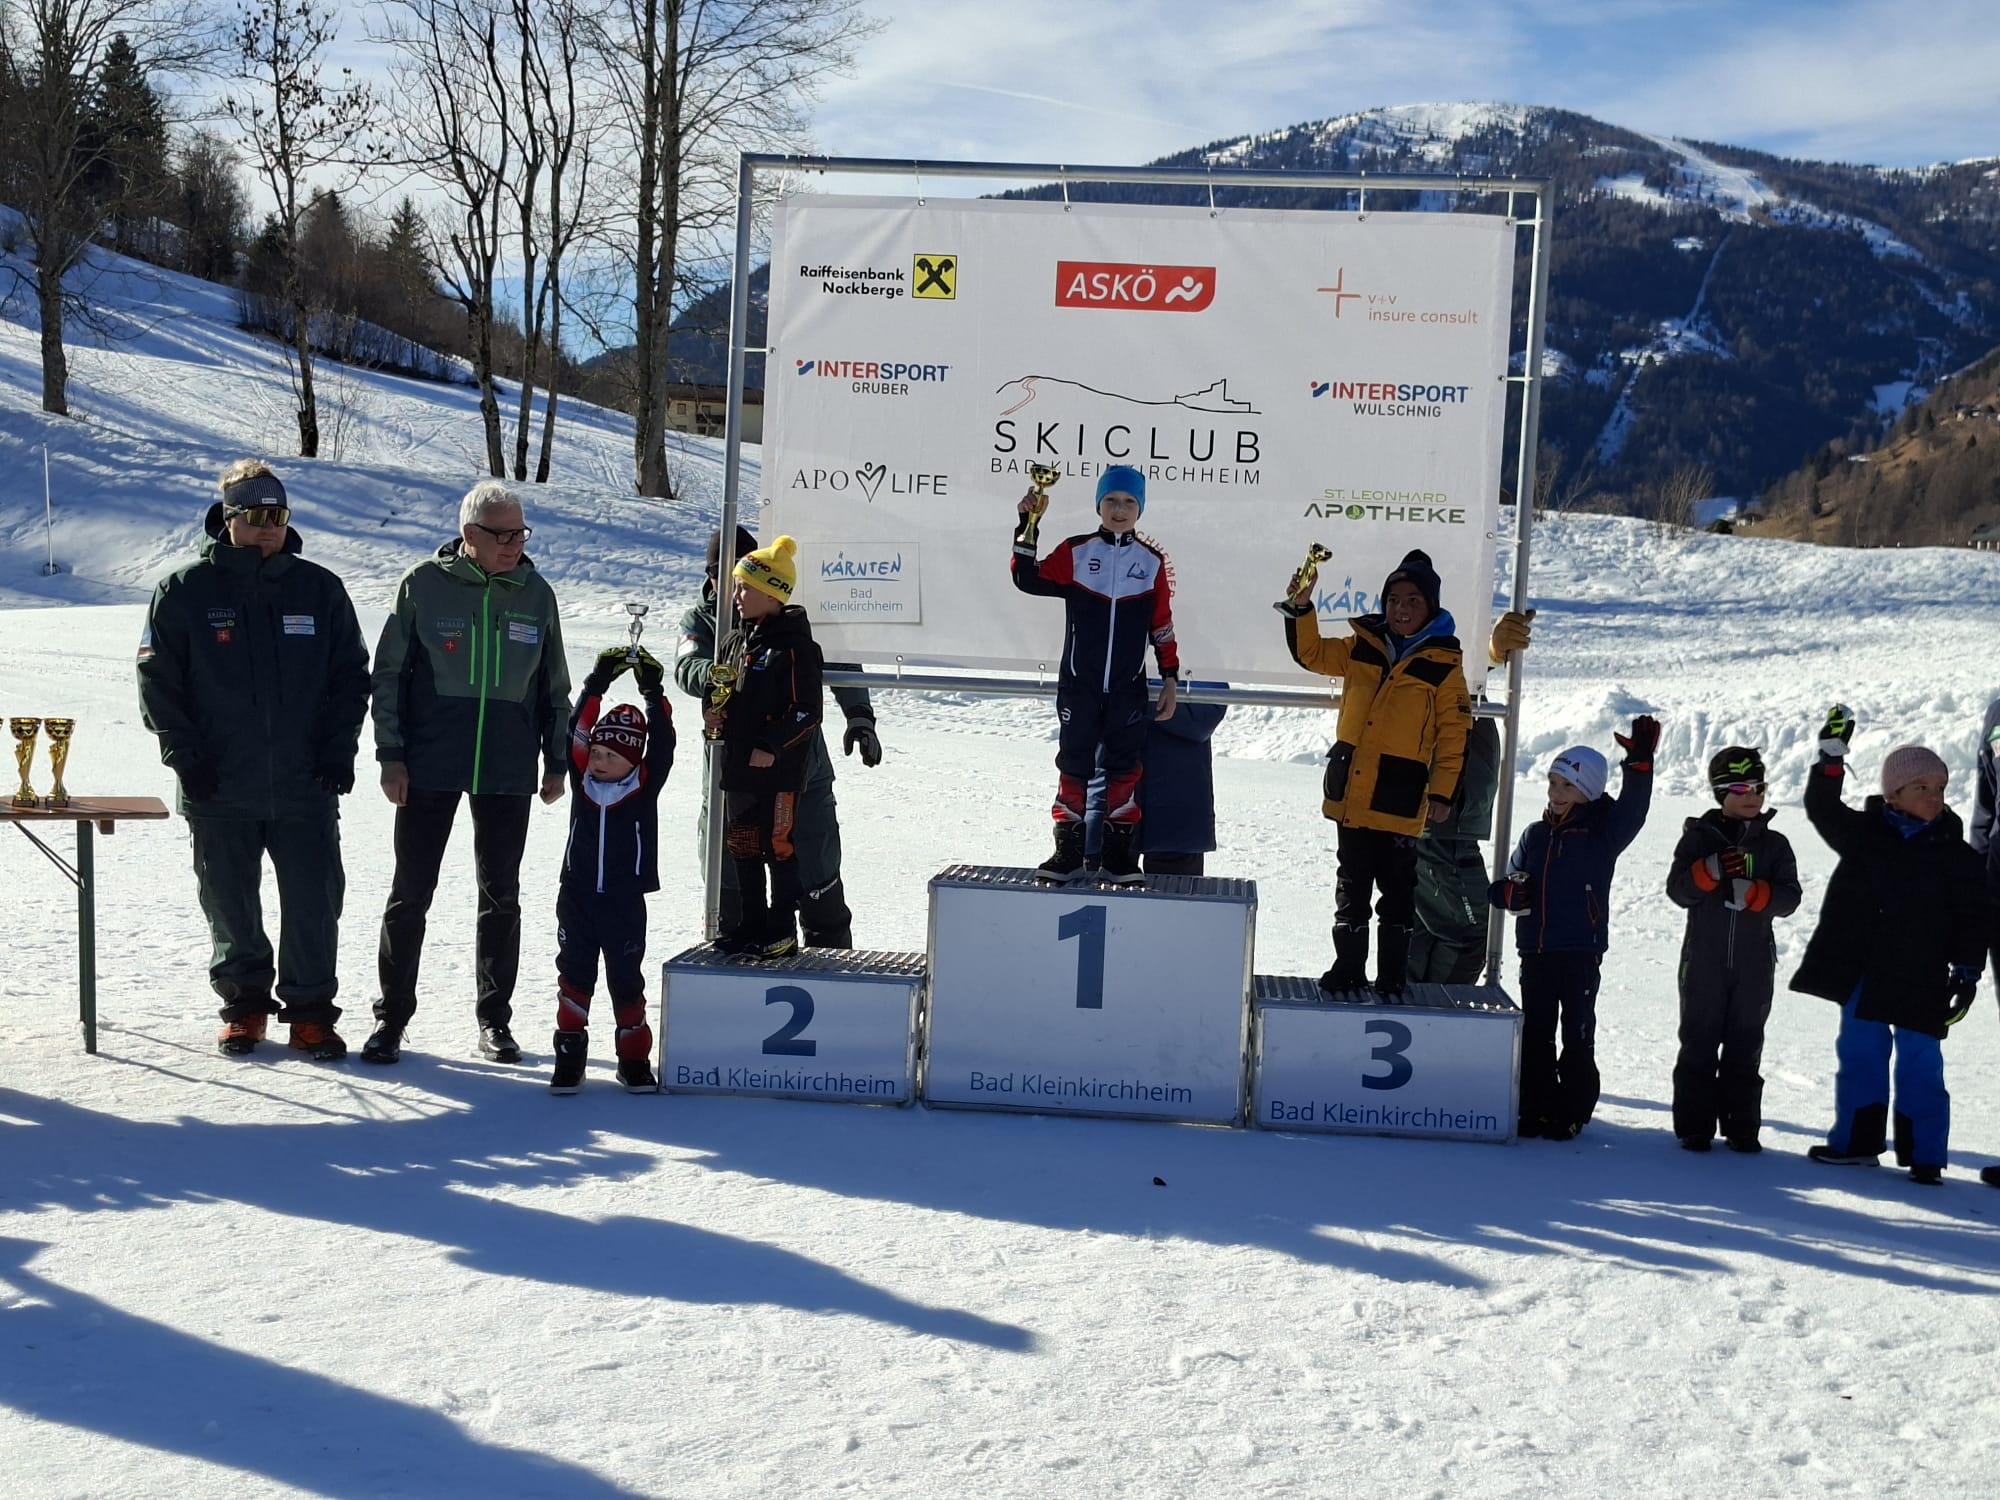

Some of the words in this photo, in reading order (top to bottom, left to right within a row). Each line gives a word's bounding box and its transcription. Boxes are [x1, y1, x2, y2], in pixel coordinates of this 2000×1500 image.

[800, 265, 904, 281] Raiffeisenbank
[823, 282, 904, 299] Nockberge
[1066, 268, 1157, 302] ASKÖ
[1369, 308, 1416, 322] insure
[1420, 309, 1478, 324] consult
[817, 360, 949, 382] INTERSPORT
[852, 382, 909, 395] GRUBER
[1332, 382, 1469, 403] INTERSPORT
[1353, 403, 1442, 418] WULSCHNIG
[993, 420, 1261, 464] SKICLUB
[791, 468, 849, 491] APO
[891, 473, 948, 496] LIFE
[1052, 460, 1261, 485] KLEIIRCHHEIM
[1324, 488, 1345, 500] ST.
[1351, 489, 1447, 503] LEONHARD
[1304, 503, 1466, 524] APOTHEKE
[821, 551, 901, 577] KÄRNTEN
[850, 588, 872, 599] Bad
[820, 600, 903, 612] Kleinkirchheim
[596, 731, 643, 748] SPORT
[1058, 904, 1107, 1009] 1
[762, 985, 817, 1057] 2
[1361, 1019, 1413, 1090] 3
[677, 1065, 720, 1087] Bad
[728, 1067, 895, 1095] Kleinkirchheim
[970, 1071, 1013, 1092] Bad
[1022, 1074, 1192, 1103] Kleinkirchheim
[1271, 1100, 1314, 1122] Bad
[1324, 1102, 1497, 1130] Kleinkirchheim
